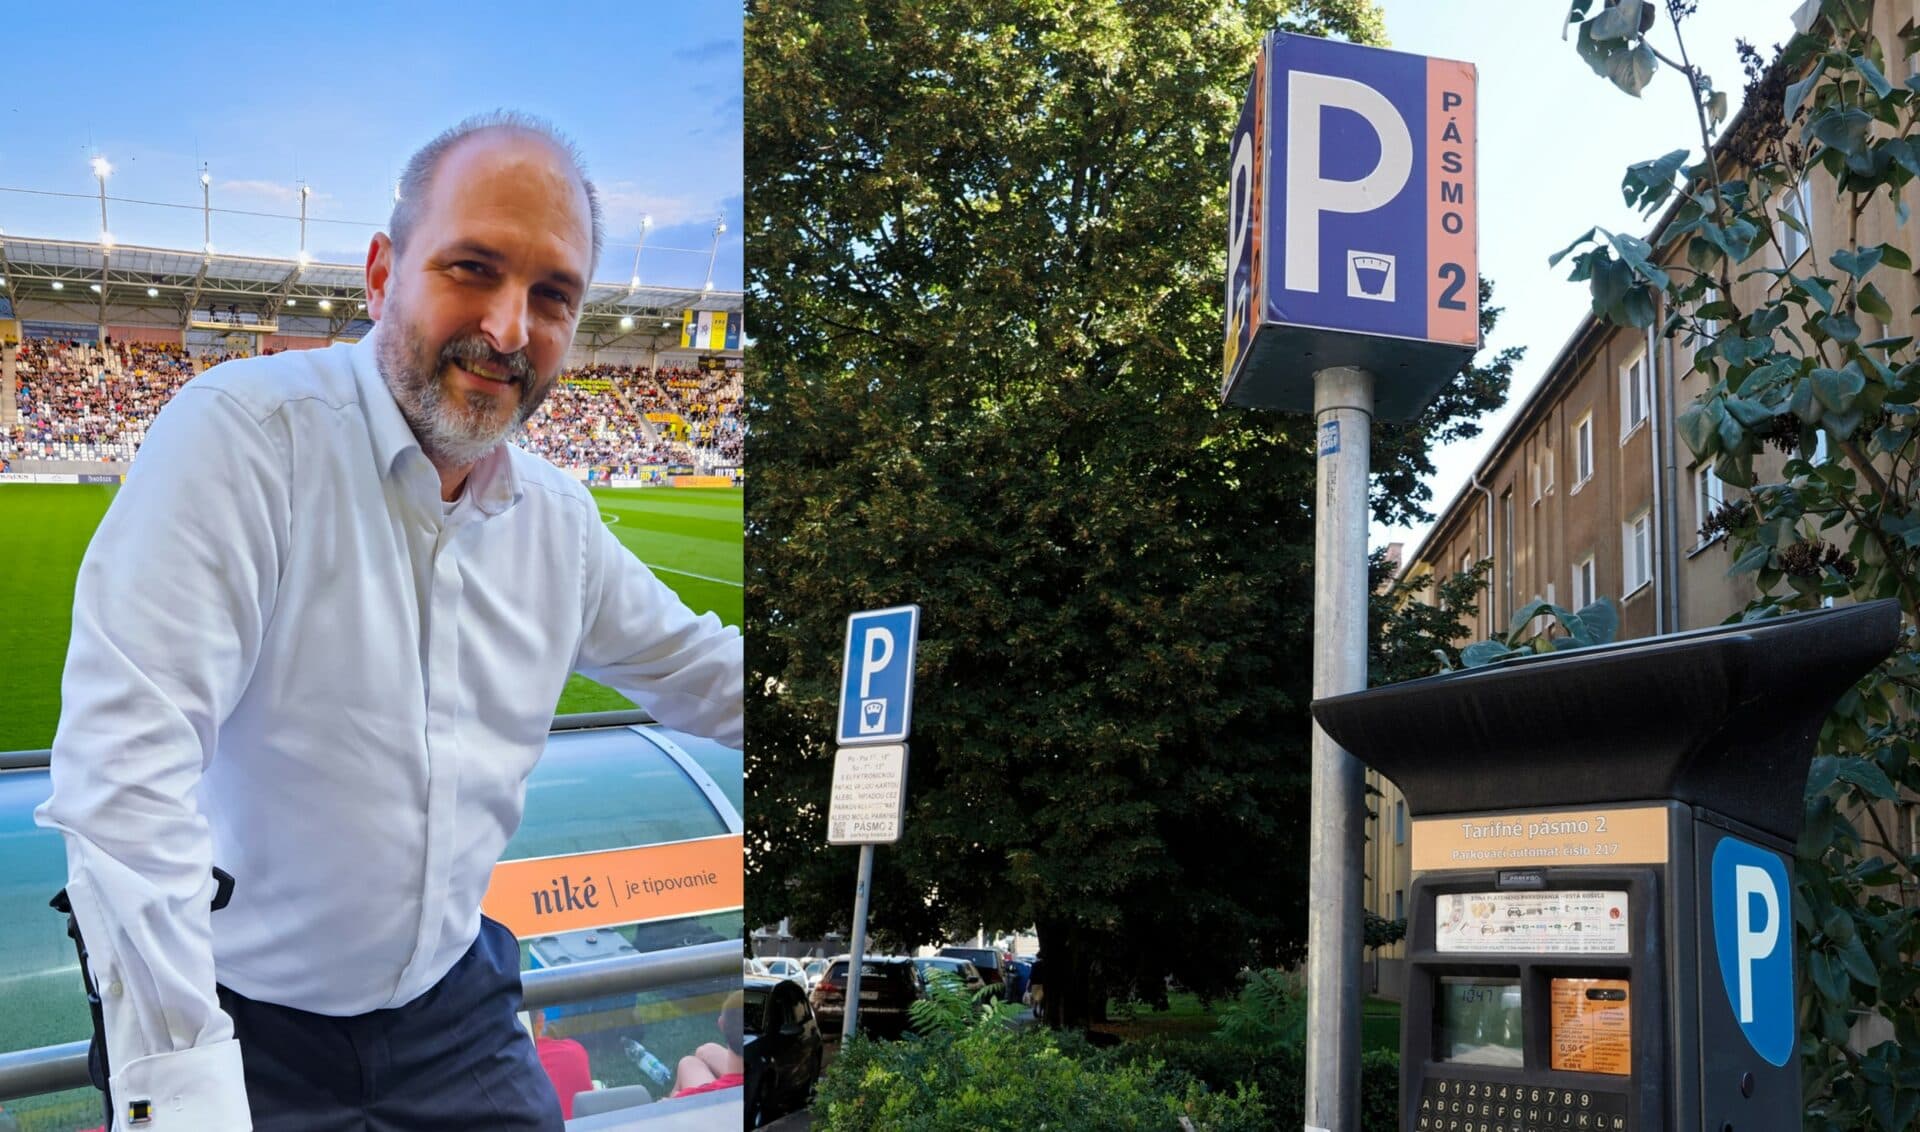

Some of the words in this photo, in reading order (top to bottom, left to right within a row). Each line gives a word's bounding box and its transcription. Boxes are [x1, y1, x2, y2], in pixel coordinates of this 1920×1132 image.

[1284, 69, 1414, 294] P
[1441, 92, 1464, 235] PÁSMO
[1438, 262, 1467, 311] 2
[860, 626, 895, 698] P
[1462, 817, 1523, 839] Tarifné
[1528, 816, 1589, 840] pásmo
[1595, 816, 1607, 833] 2
[1509, 846, 1559, 859] automat
[1595, 843, 1619, 856] 217
[531, 875, 600, 915] niké
[625, 879, 640, 900] je
[643, 869, 718, 896] tipovanie
[1735, 864, 1780, 1024] P
[1422, 1099, 1430, 1108] A
[1437, 1100, 1445, 1111] B
[1452, 1102, 1459, 1112] C
[1467, 1103, 1474, 1114] D
[1482, 1105, 1489, 1115] E
[1498, 1106, 1505, 1117] F
[1513, 1108, 1522, 1119] G
[1529, 1110, 1537, 1120] H
[1548, 1111, 1552, 1121] I
[1563, 1114, 1570, 1124] J
[1579, 1115, 1587, 1125] K
[1597, 1117, 1604, 1127] L
[1613, 1118, 1623, 1129] M
[1439, 1082, 1446, 1093] 0
[1455, 1083, 1460, 1094] 1
[1468, 1084, 1476, 1096] 2
[1484, 1086, 1491, 1097] 3
[1499, 1087, 1507, 1098] 4
[1515, 1088, 1523, 1100] 5
[1531, 1090, 1539, 1102] 6
[1548, 1091, 1556, 1103] 7
[1564, 1092, 1572, 1105] 8
[1581, 1094, 1589, 1106] 9
